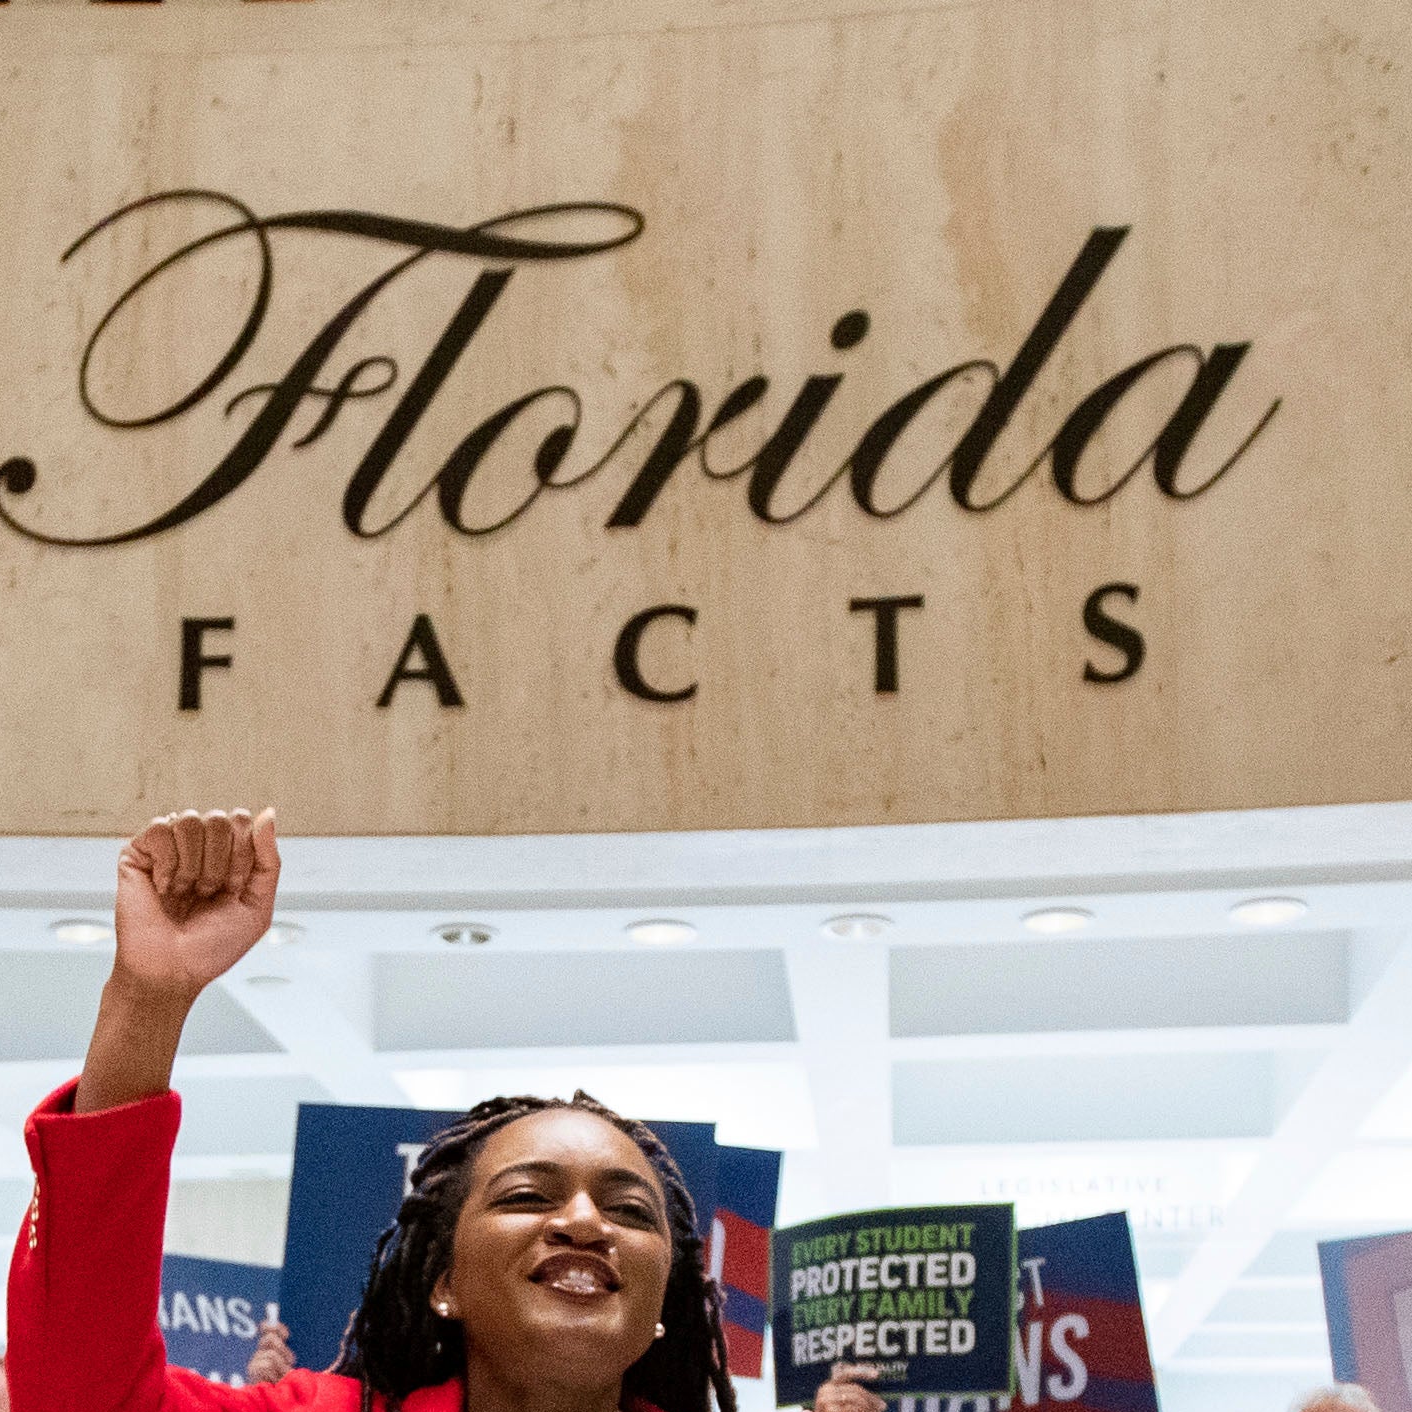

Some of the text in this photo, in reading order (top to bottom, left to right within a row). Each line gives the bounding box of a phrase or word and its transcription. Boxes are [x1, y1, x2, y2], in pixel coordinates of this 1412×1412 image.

[176, 581, 1147, 716] FACTS
[980, 1176, 1169, 1197] LEGISLATIVE
[792, 1222, 975, 1266] EVERY STUDENT
[790, 1252, 976, 1299] PROTECTED
[158, 1290, 259, 1340] ANS
[858, 1289, 974, 1319] FAMILY
[793, 1318, 976, 1365] RESPECTED
